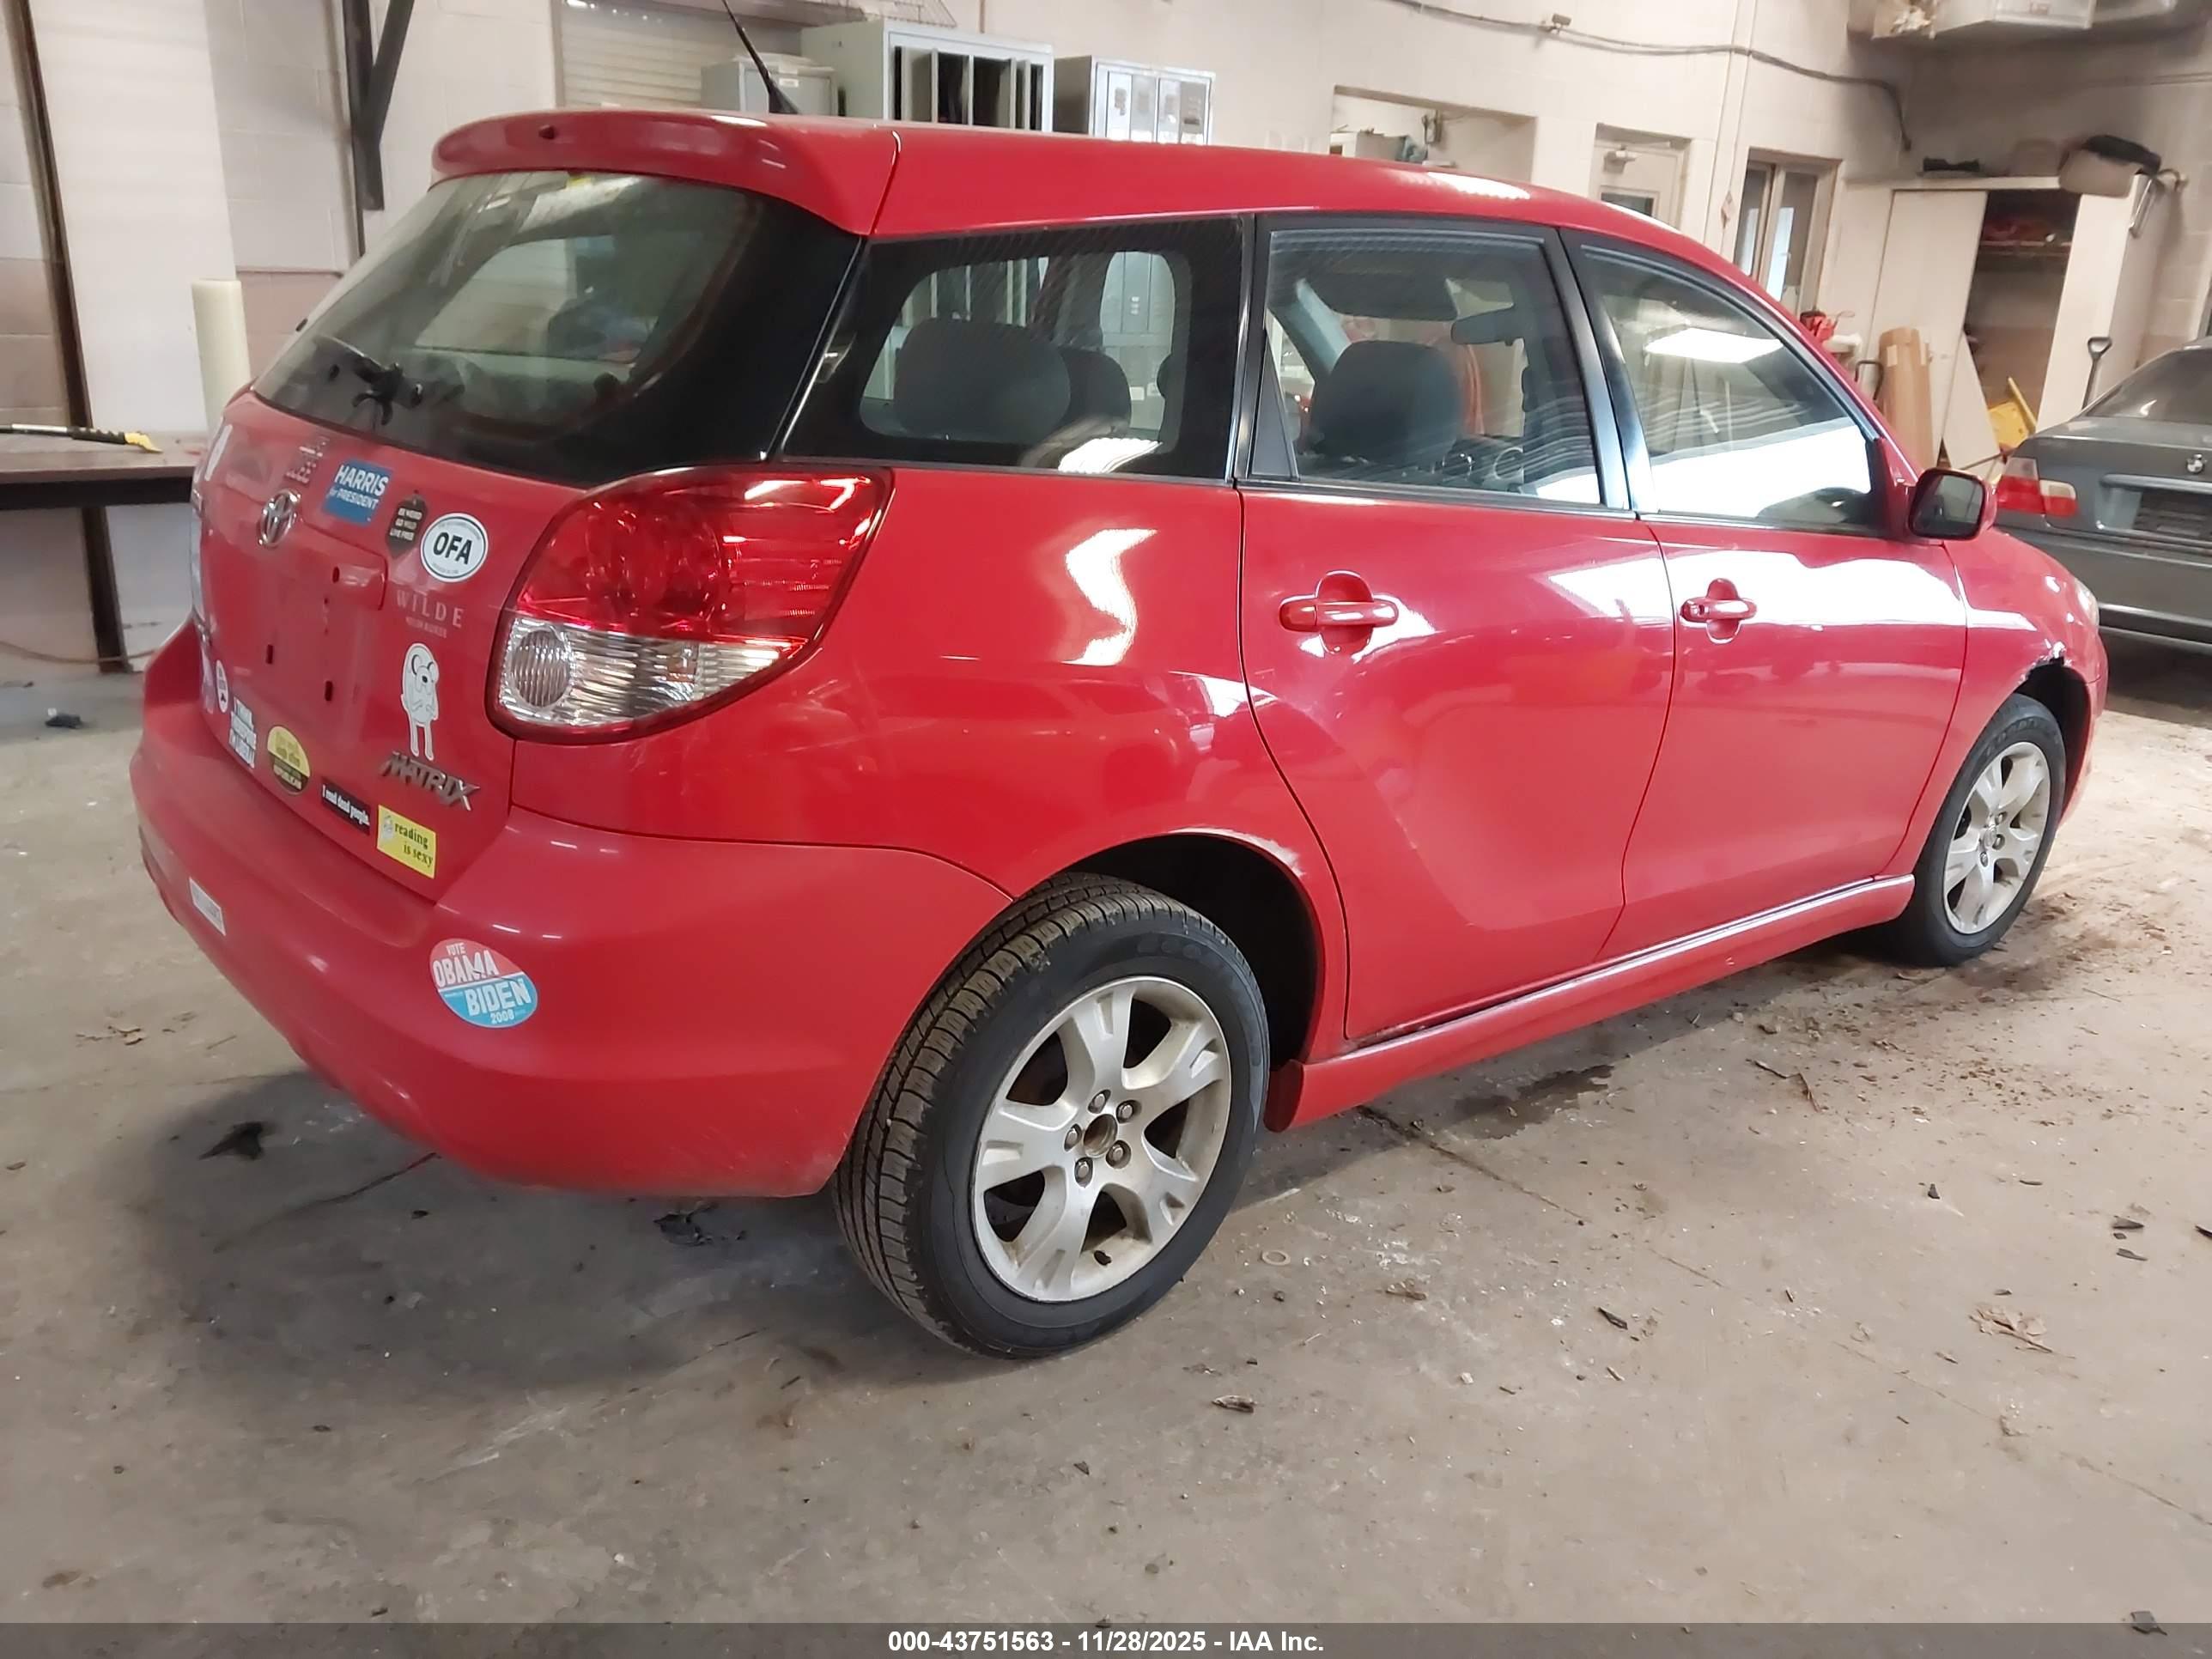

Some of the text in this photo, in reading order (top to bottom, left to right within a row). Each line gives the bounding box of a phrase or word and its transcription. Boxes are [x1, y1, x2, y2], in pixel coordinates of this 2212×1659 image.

[334, 464, 389, 496] HARRIS
[336, 489, 379, 510] PRESIDENT
[433, 532, 472, 565] OFA
[397, 590, 464, 628] WILDE
[379, 751, 480, 811] MATRIX
[395, 823, 429, 850] reading
[404, 842, 434, 867] is sexy
[447, 943, 465, 956] VOTE
[433, 950, 500, 988] OBAMA
[465, 977, 532, 1017] BIDEN
